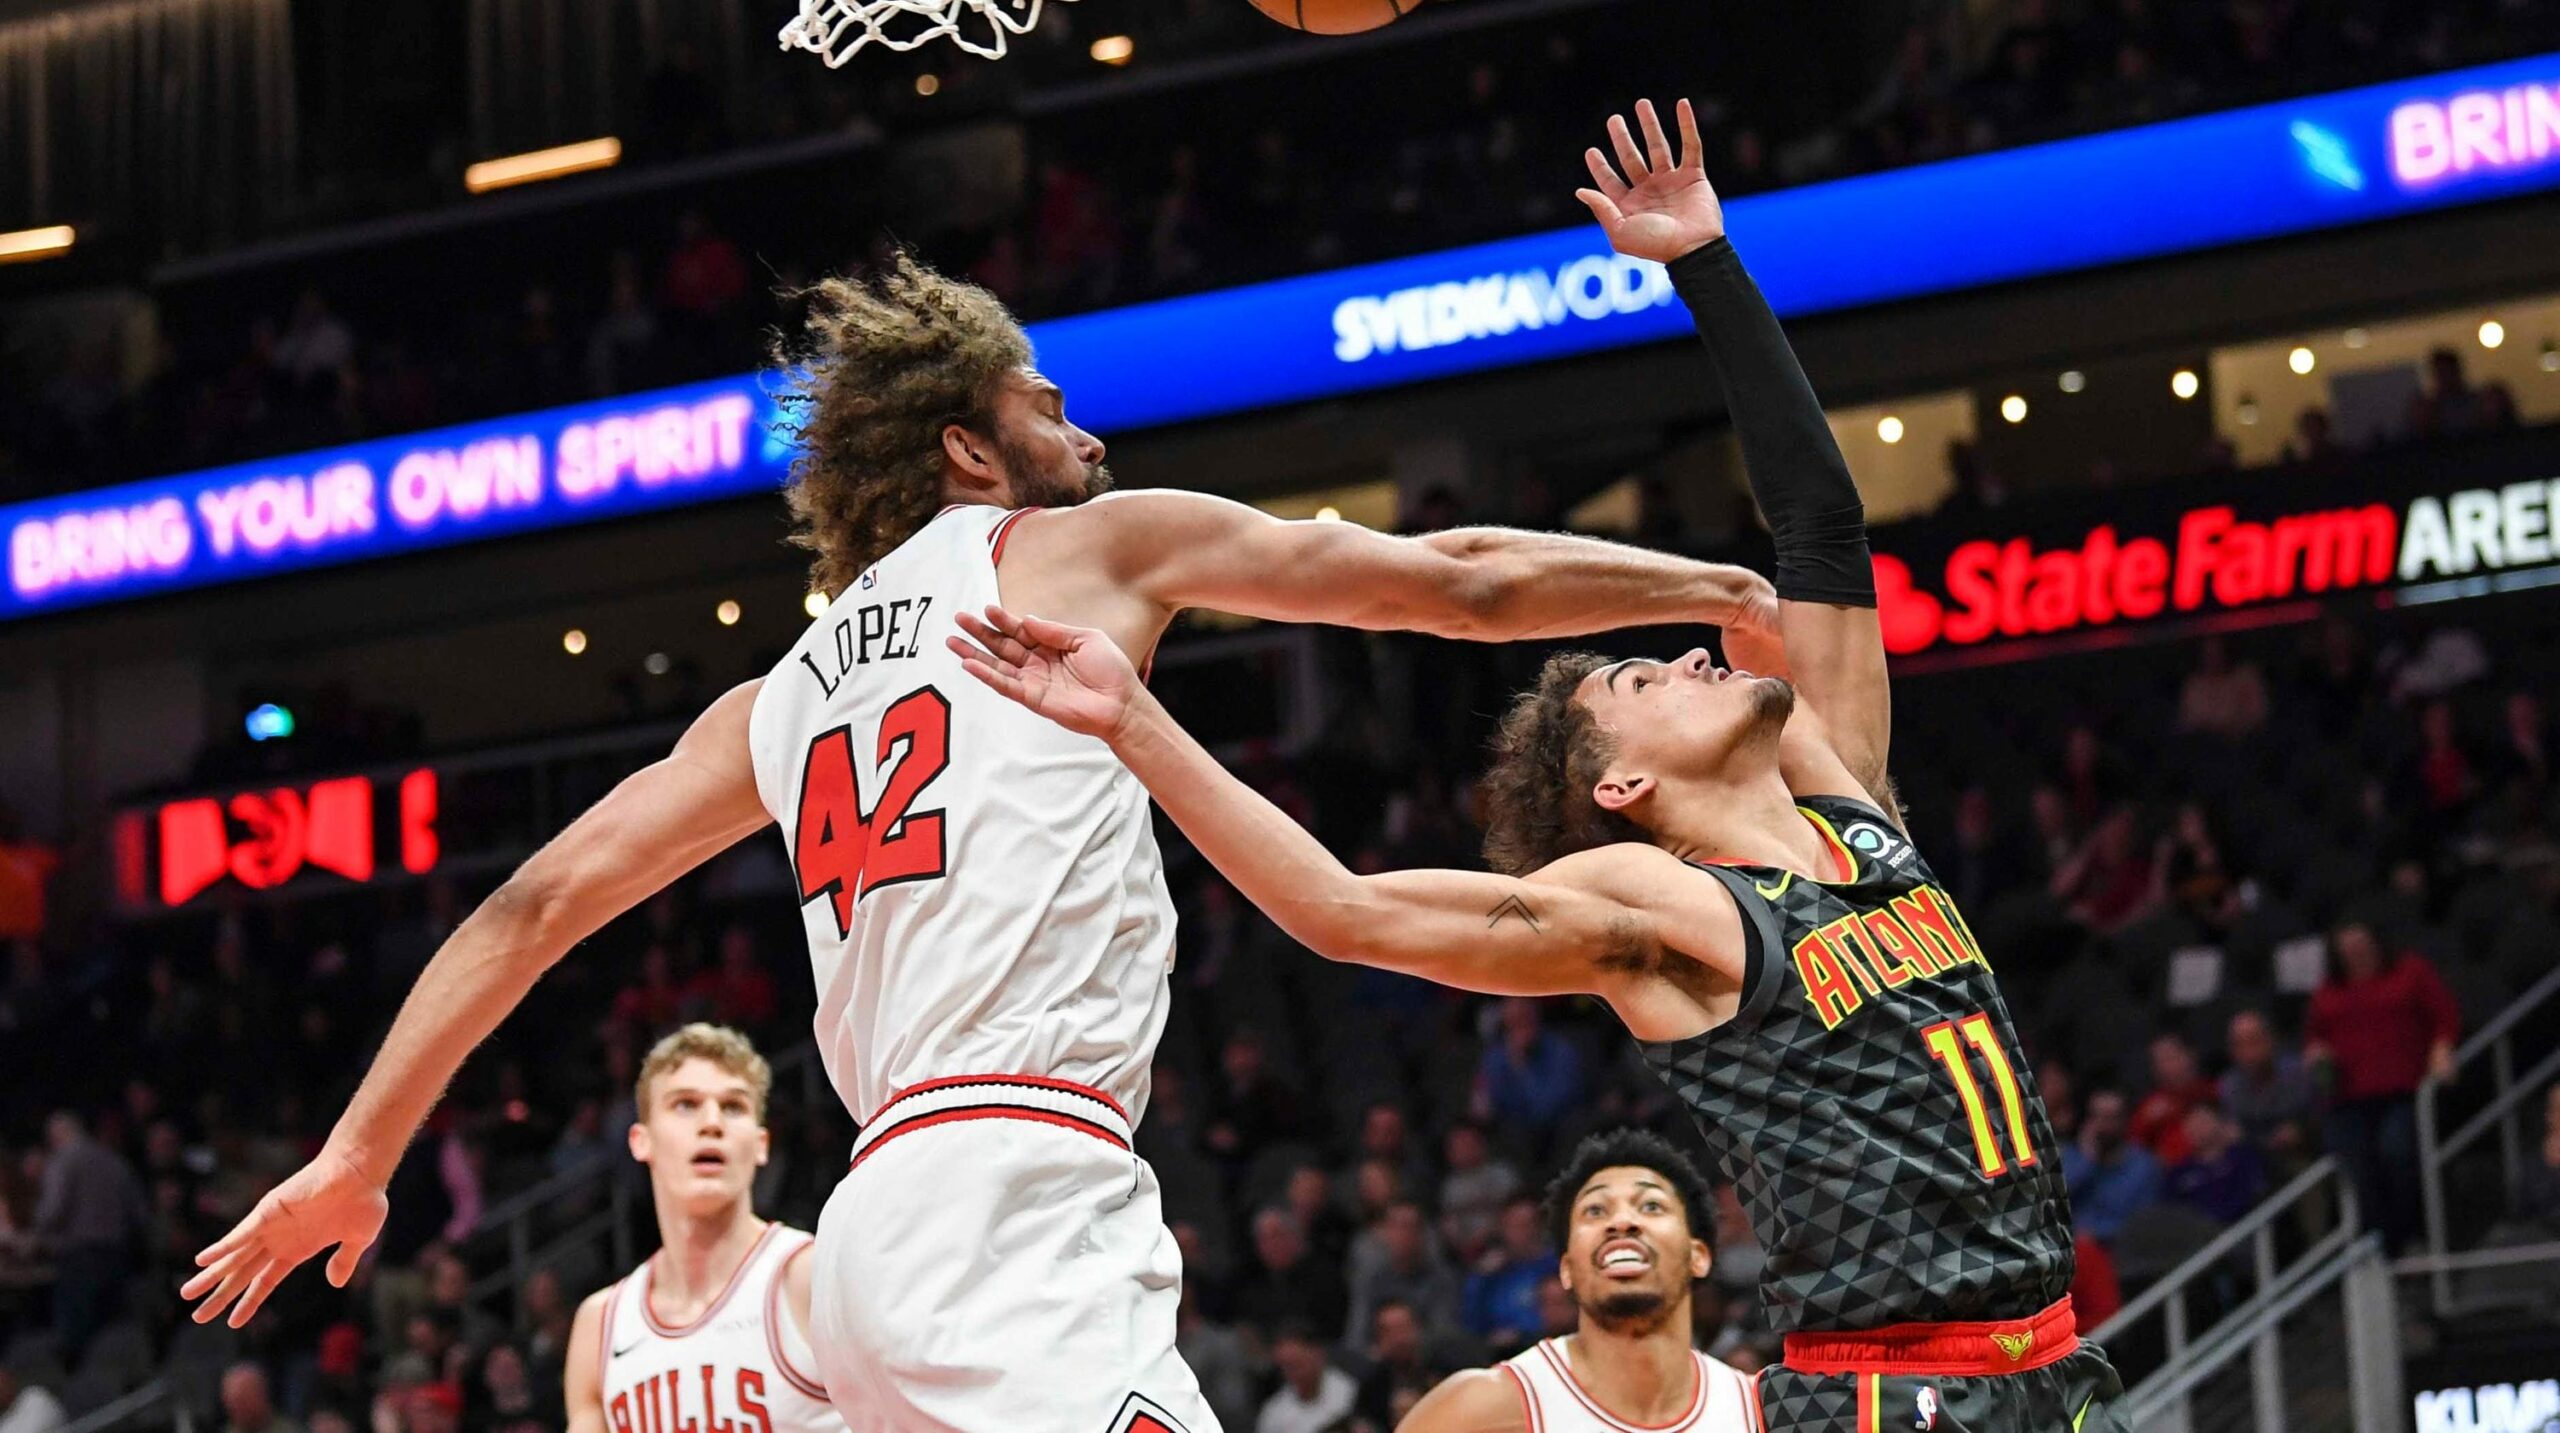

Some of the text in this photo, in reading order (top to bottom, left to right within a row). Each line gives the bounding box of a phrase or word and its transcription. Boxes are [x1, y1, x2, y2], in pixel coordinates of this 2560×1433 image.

[10, 394, 753, 597] BRING YOUR OWN SPIRIT
[1944, 477, 2560, 643] State Farm ARE
[799, 595, 933, 701] LOPEZ
[793, 683, 952, 942] 42
[1920, 1010, 2037, 1179] 11
